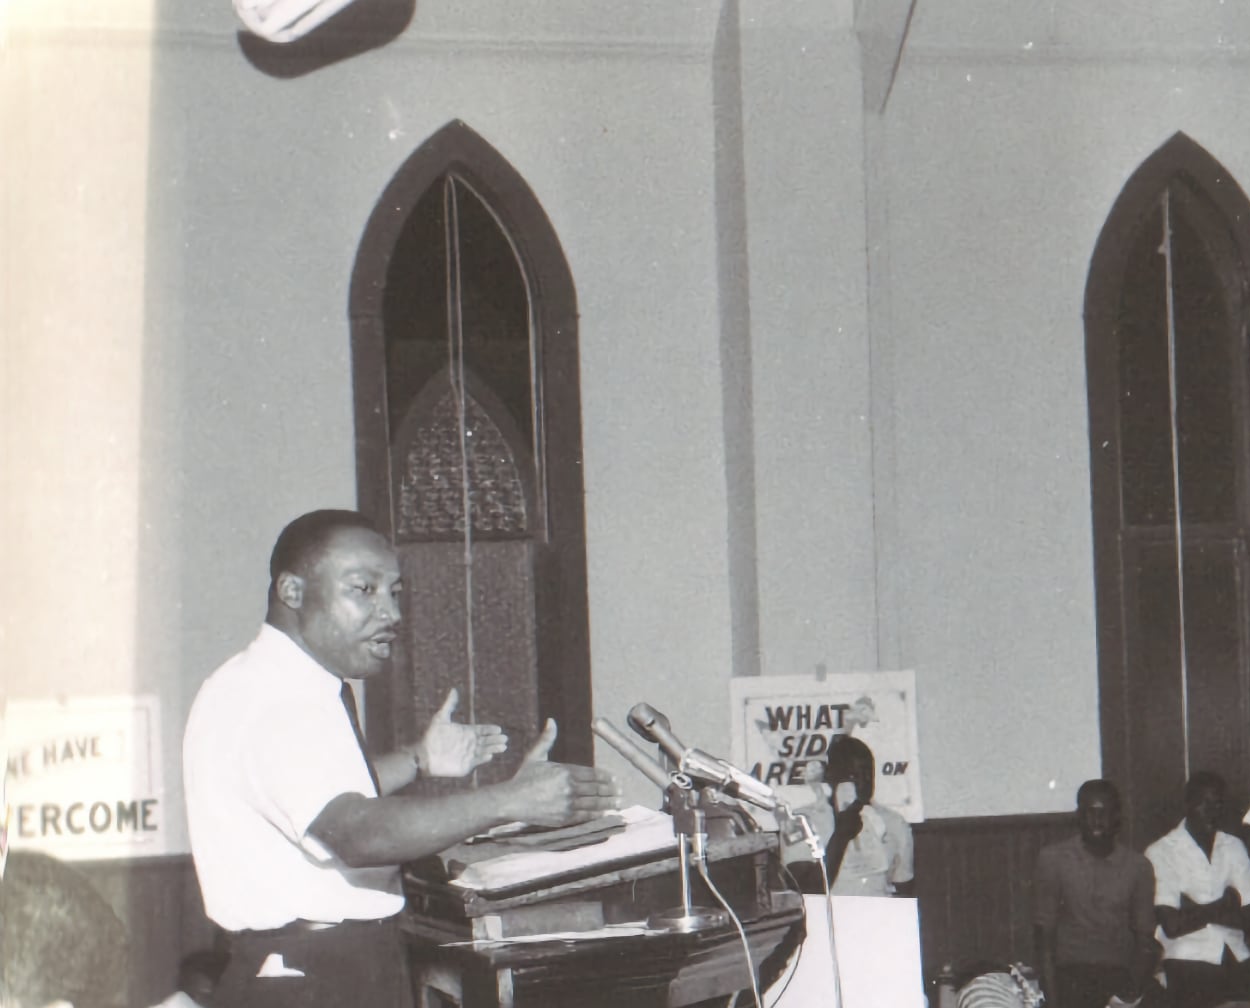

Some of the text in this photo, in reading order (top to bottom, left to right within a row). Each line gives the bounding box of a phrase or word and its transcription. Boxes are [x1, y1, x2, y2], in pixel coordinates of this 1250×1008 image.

[765, 704, 850, 731] WHAT
[42, 734, 102, 768] HAVE
[882, 761, 909, 776] ON
